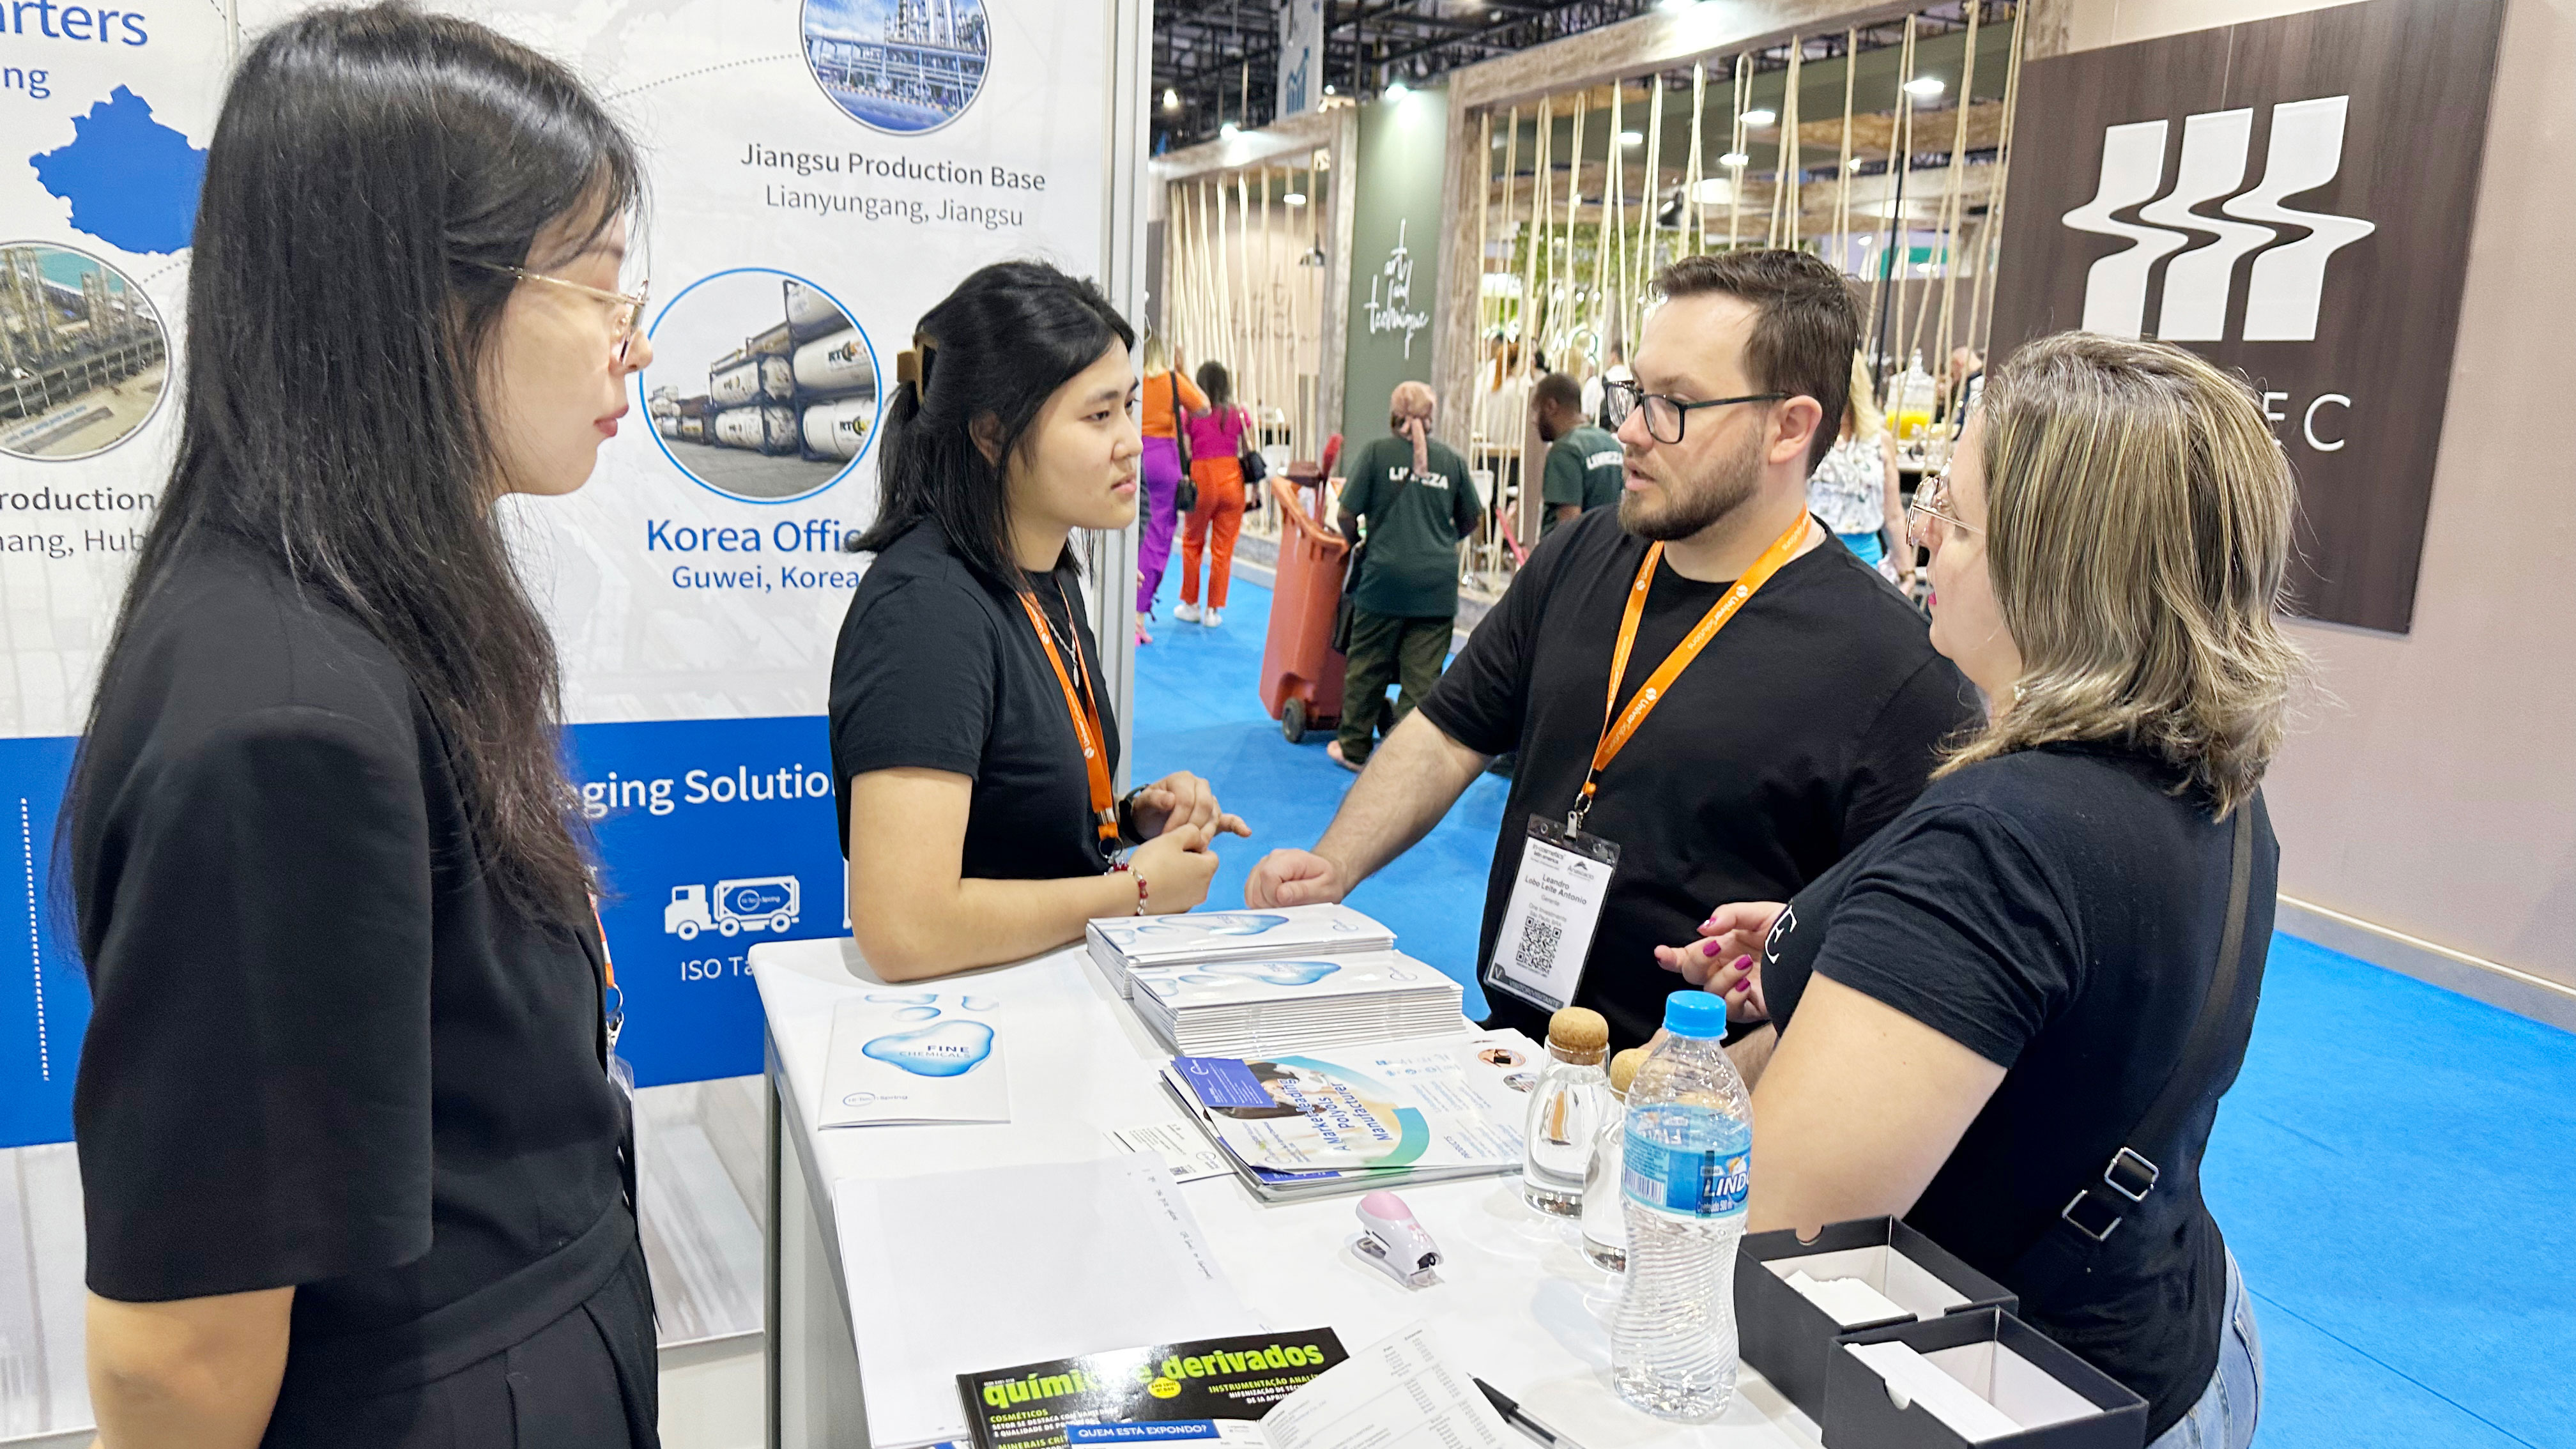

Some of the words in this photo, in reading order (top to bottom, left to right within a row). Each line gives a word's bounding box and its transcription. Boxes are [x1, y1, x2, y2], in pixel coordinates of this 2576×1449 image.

[0, 0, 148, 46] rters
[741, 142, 839, 176] Jiangsu
[848, 152, 983, 186] Production
[991, 166, 1046, 191] Base
[767, 185, 929, 225] Lianyungang,
[937, 199, 1023, 230] Jiangsu
[0, 535, 74, 559] ang,
[648, 519, 761, 552] Korea
[673, 565, 771, 594] Guwei,
[781, 566, 860, 588] Korea
[684, 763, 836, 804] Solutio
[1524, 875, 1540, 887] Lobo
[1541, 882, 1557, 894] Leite
[1558, 889, 1587, 905] Antonio
[1542, 873, 1570, 890] Leandro
[681, 958, 722, 981] ISO
[928, 1045, 970, 1054] FINE
[1703, 1172, 1749, 1197] LIND
[1162, 1344, 1324, 1380] derivados
[1208, 1377, 1287, 1393] INSTRUMENTAÇÃO
[1246, 1396, 1257, 1404] DE
[990, 1408, 1048, 1423] COSMÉTICOS
[992, 1421, 1016, 1430] SETOR
[1027, 1415, 1060, 1426] DESTACA
[1000, 1425, 1043, 1437] QUALIDADE
[1044, 1422, 1054, 1430] DE
[1078, 1427, 1115, 1438] QUEM
[1117, 1423, 1144, 1436] ESTÁ
[1147, 1424, 1206, 1435] EXPONDO?
